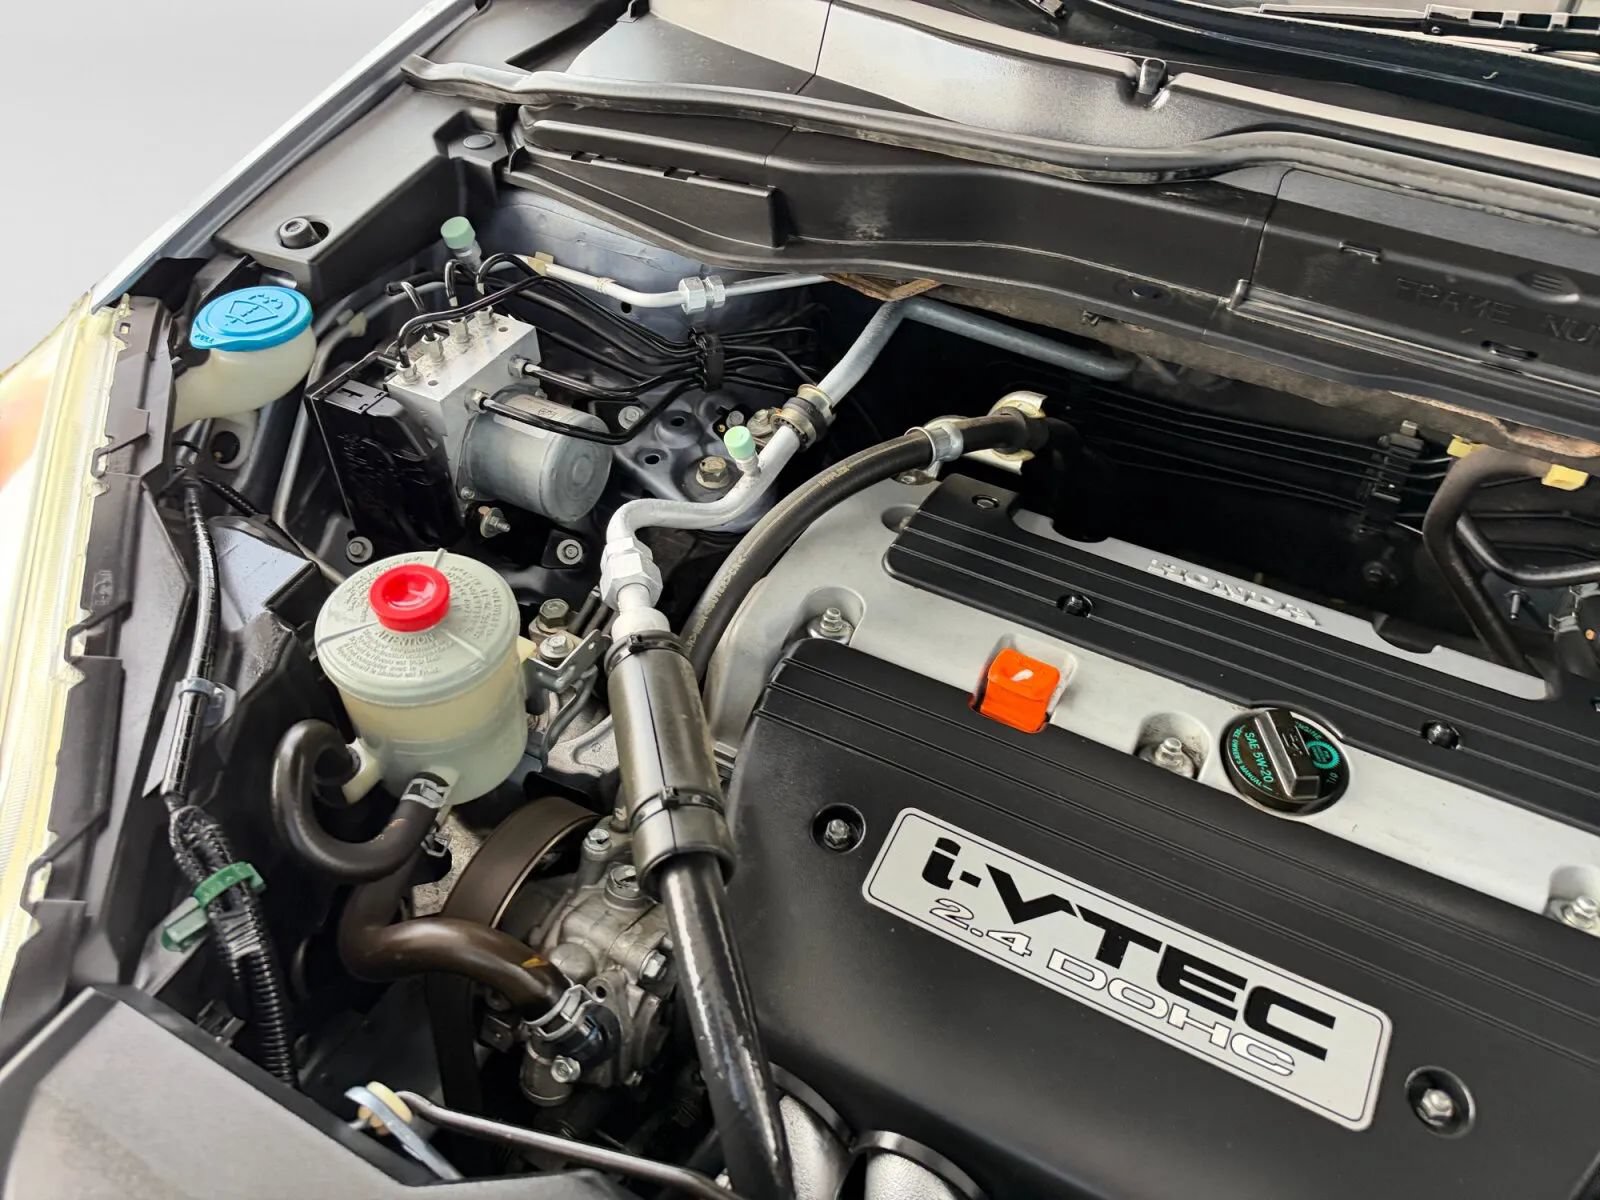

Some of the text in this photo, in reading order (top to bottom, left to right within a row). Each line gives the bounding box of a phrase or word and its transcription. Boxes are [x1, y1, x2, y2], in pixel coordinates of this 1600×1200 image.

[1397, 277, 1600, 345] FRAME NU
[1148, 558, 1321, 626] HONDA
[375, 629, 435, 647] ATTENTION
[1231, 738, 1243, 765] OWNER'S
[1240, 765, 1263, 787] MANUAL
[1244, 732, 1274, 783] SAE 5W-20
[1326, 772, 1338, 785] OIL
[921, 837, 1336, 1061] i-VTEC
[929, 898, 1295, 1077] 2.4 DOHC
